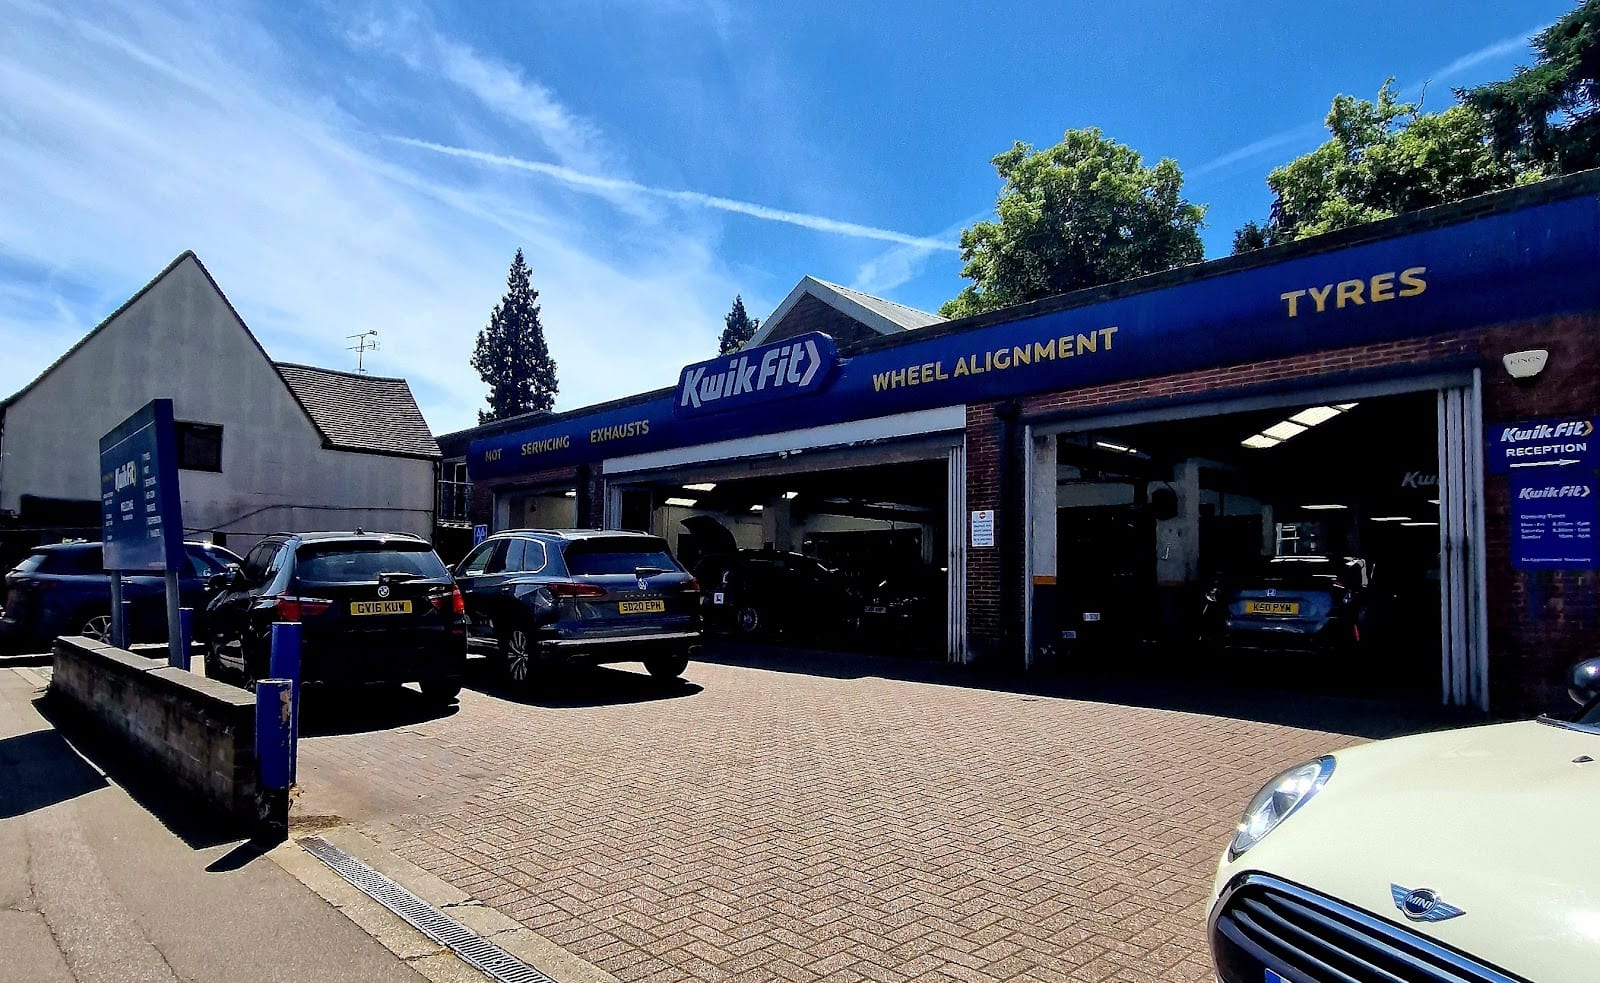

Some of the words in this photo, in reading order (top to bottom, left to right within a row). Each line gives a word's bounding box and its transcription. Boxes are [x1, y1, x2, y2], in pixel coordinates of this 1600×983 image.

[1280, 266, 1427, 318] TYRES
[872, 361, 949, 392] WHEEL
[953, 326, 1119, 377] ALIGNMENT
[680, 356, 757, 408] Kwik
[756, 343, 805, 390] Fit
[590, 420, 649, 443] EXHAUSTS
[1500, 424, 1554, 443] Kwik
[1553, 421, 1585, 438] Fit
[485, 448, 503, 462] MOT
[521, 435, 570, 456] SERVICING
[1506, 442, 1587, 458] RECEPTION
[1401, 470, 1440, 489] Kw
[1518, 487, 1560, 500] Kwik
[1559, 485, 1582, 498] Fit
[1406, 894, 1433, 910] MINI
